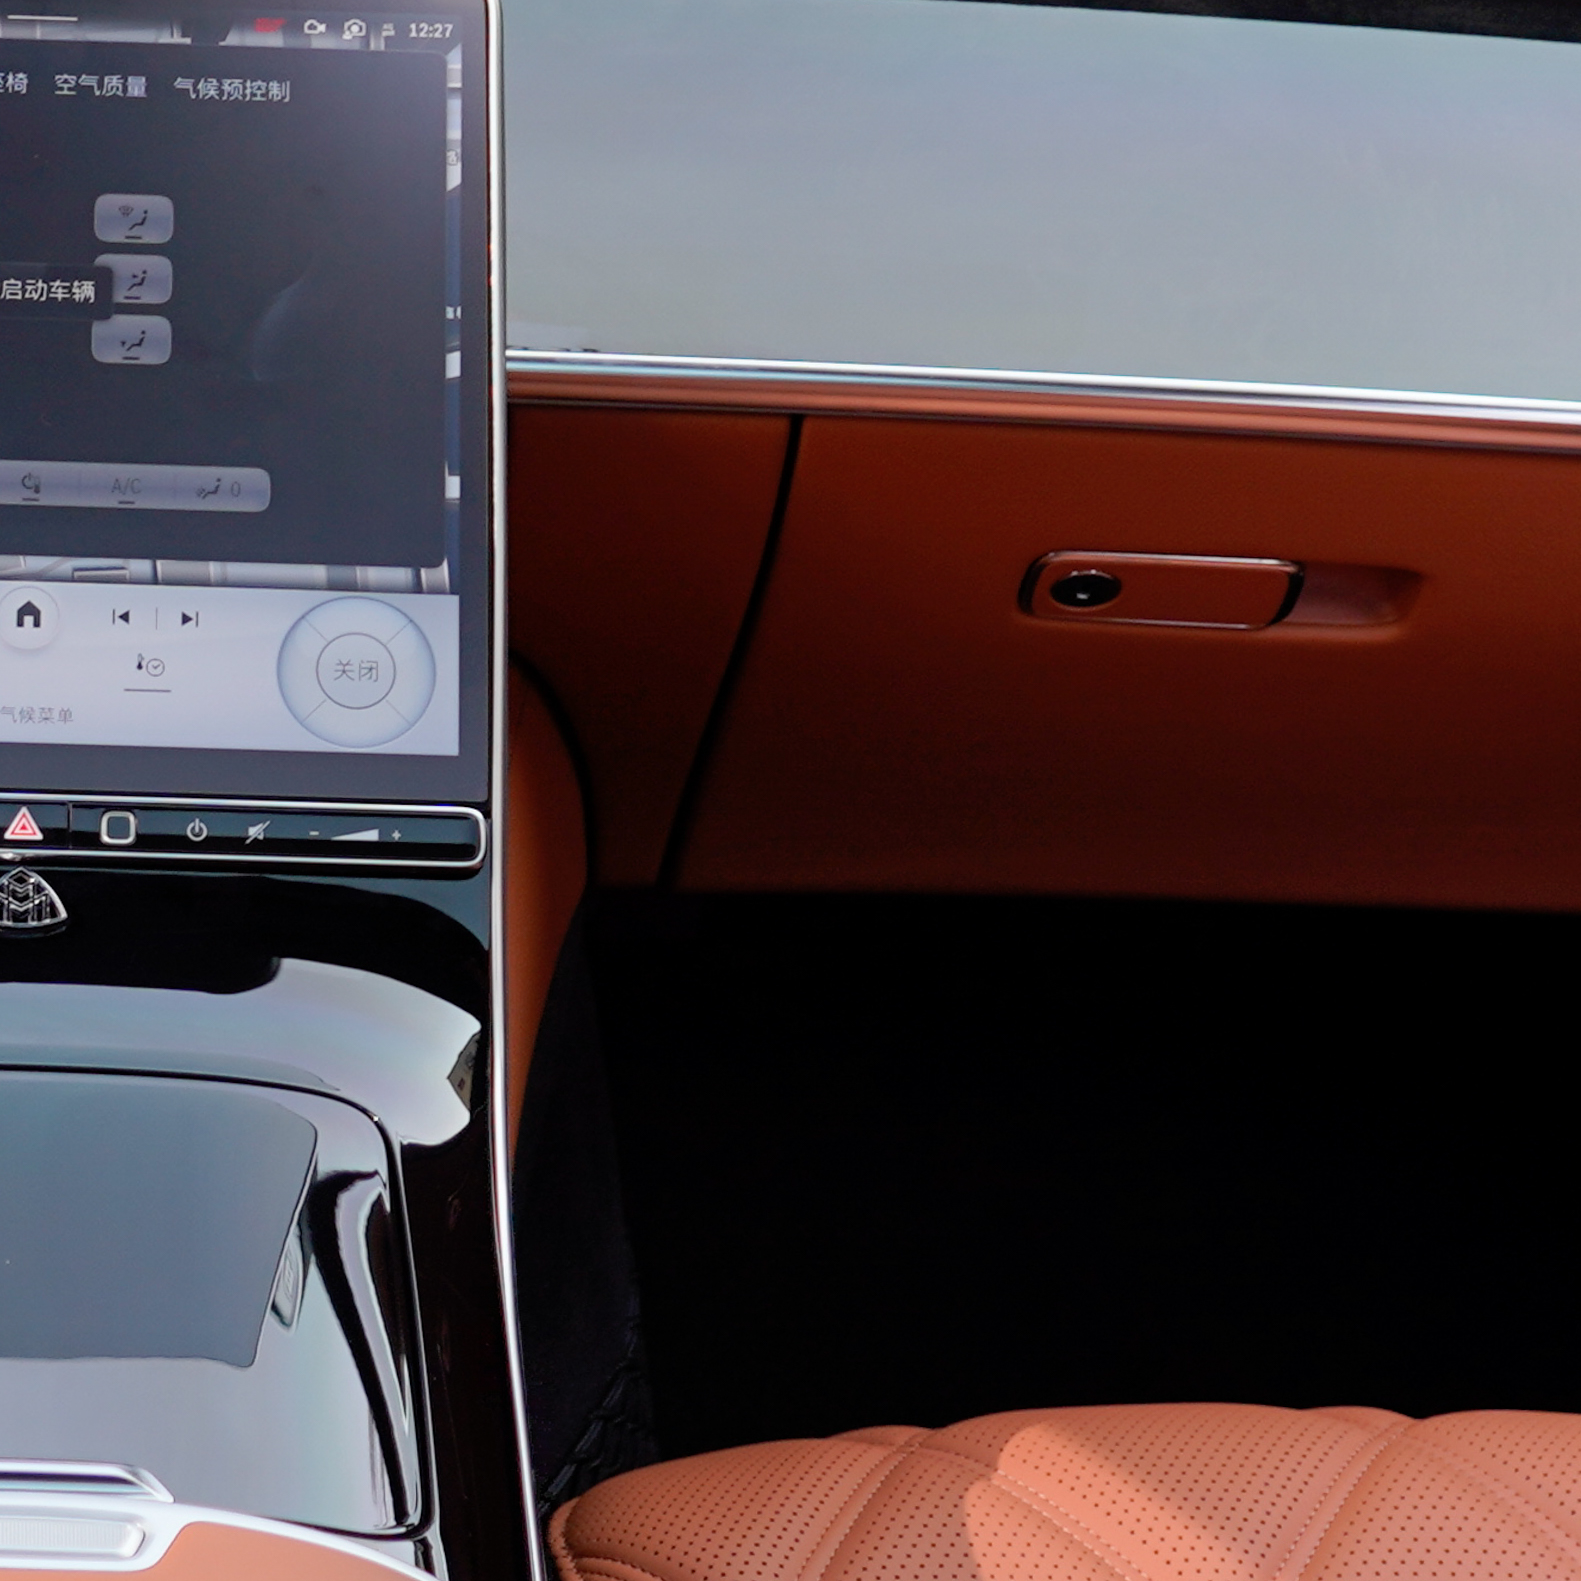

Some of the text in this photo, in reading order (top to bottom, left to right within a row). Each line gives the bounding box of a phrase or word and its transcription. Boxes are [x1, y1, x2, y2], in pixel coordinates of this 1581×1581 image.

[409, 22, 454, 39] 12:27
[53, 73, 148, 98] 空气质量
[173, 77, 291, 103] 气候预控制
[111, 477, 142, 495] A/C
[333, 659, 380, 684] 关闭
